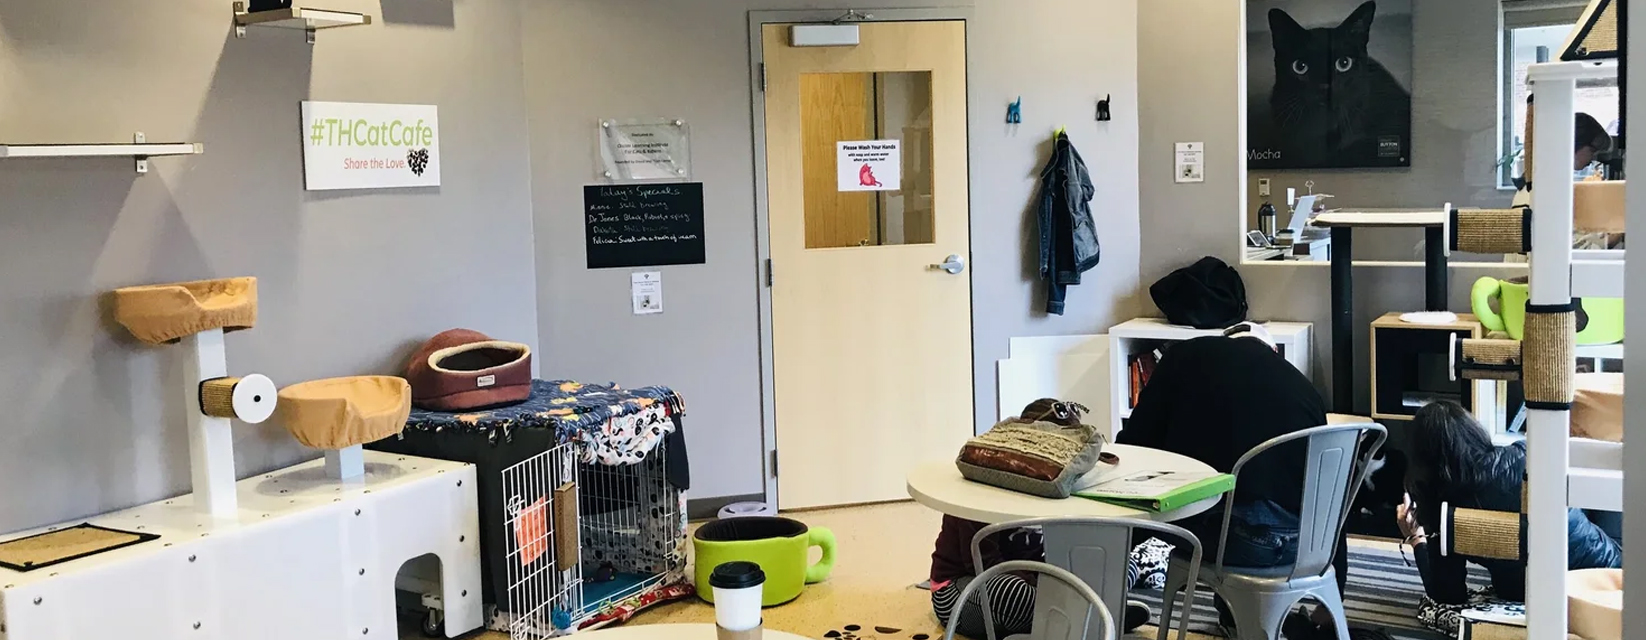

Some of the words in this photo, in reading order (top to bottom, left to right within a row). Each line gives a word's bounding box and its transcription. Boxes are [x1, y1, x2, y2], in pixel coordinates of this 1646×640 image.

[310, 118, 433, 146] #THCatCafe
[1247, 148, 1281, 160] Mocha
[343, 158, 368, 169] Share
[370, 158, 384, 169] the
[597, 213, 619, 222] Jones
